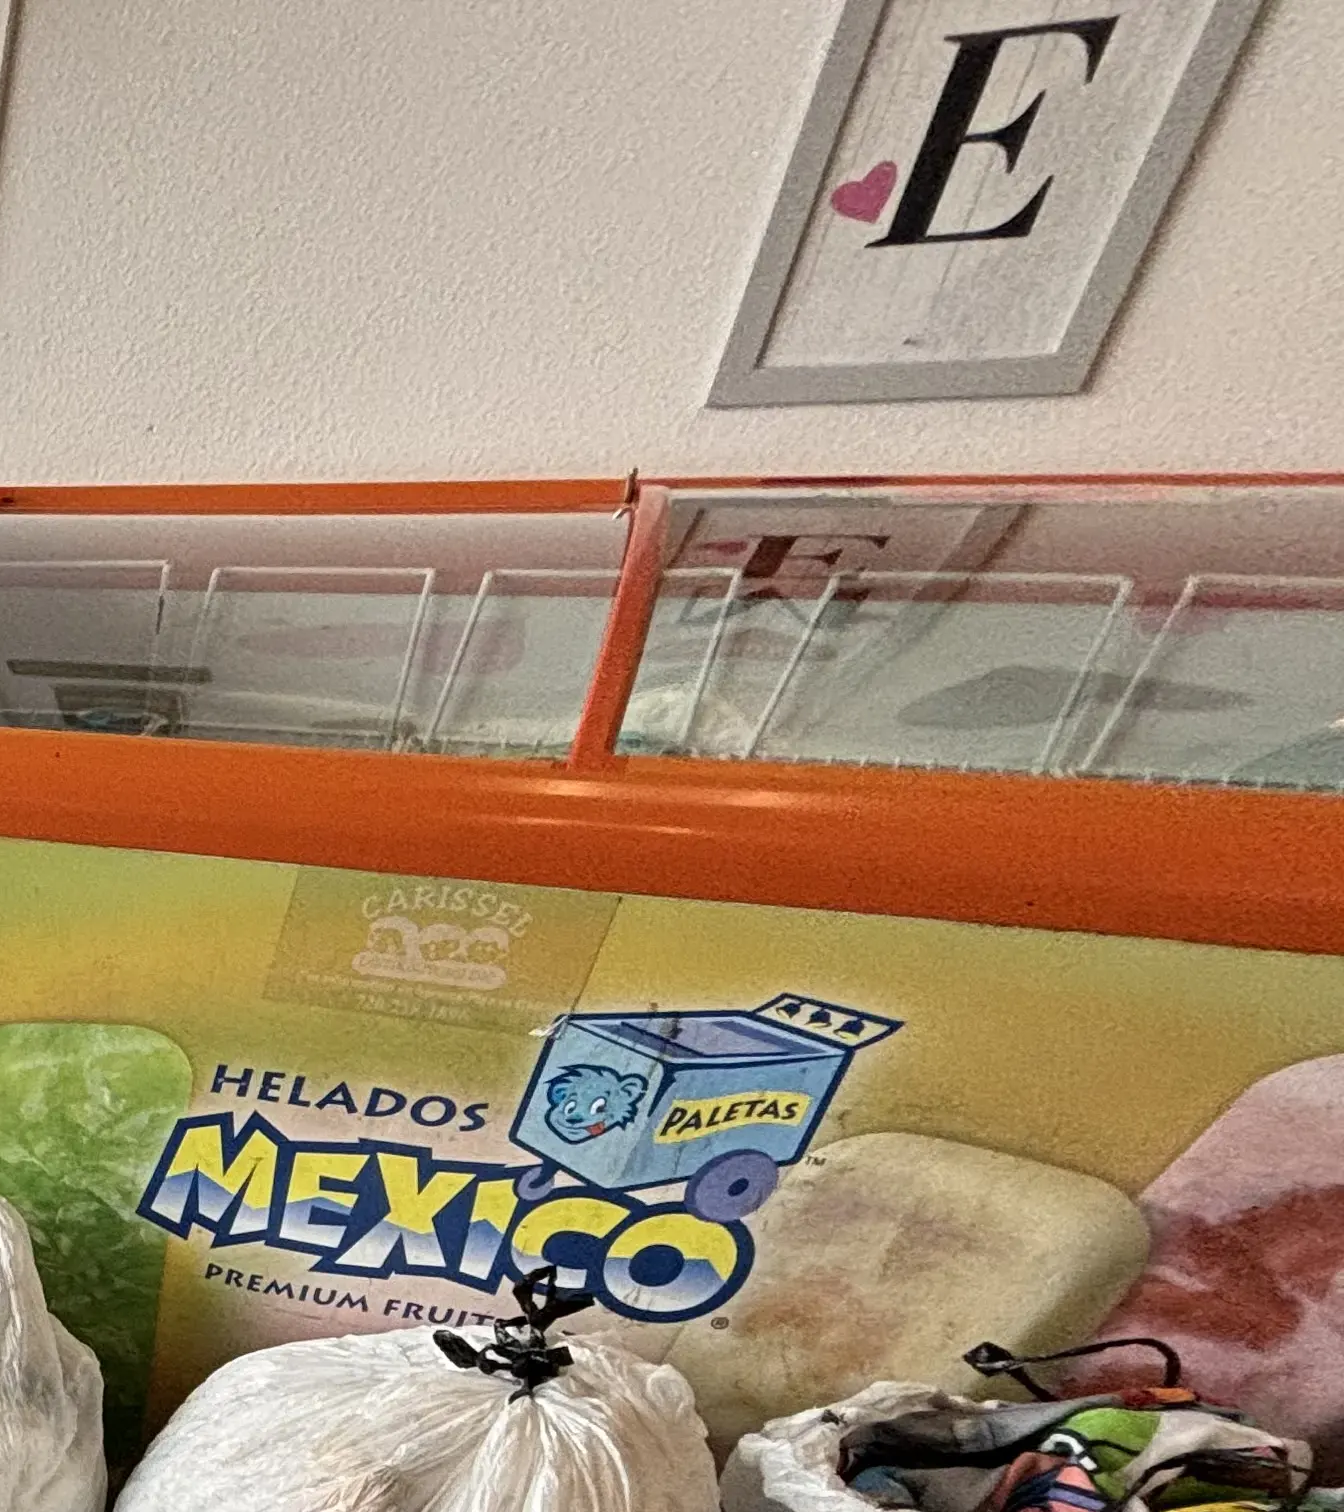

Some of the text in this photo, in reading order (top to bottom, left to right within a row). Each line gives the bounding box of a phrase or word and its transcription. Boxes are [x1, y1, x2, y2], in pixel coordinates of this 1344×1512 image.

[865, 16, 1120, 249] E
[210, 1064, 490, 1132] HELADOS
[659, 1099, 800, 1137] PALETAS
[137, 1111, 756, 1324] MEXICO
[205, 1263, 369, 1314] PREMIUM
